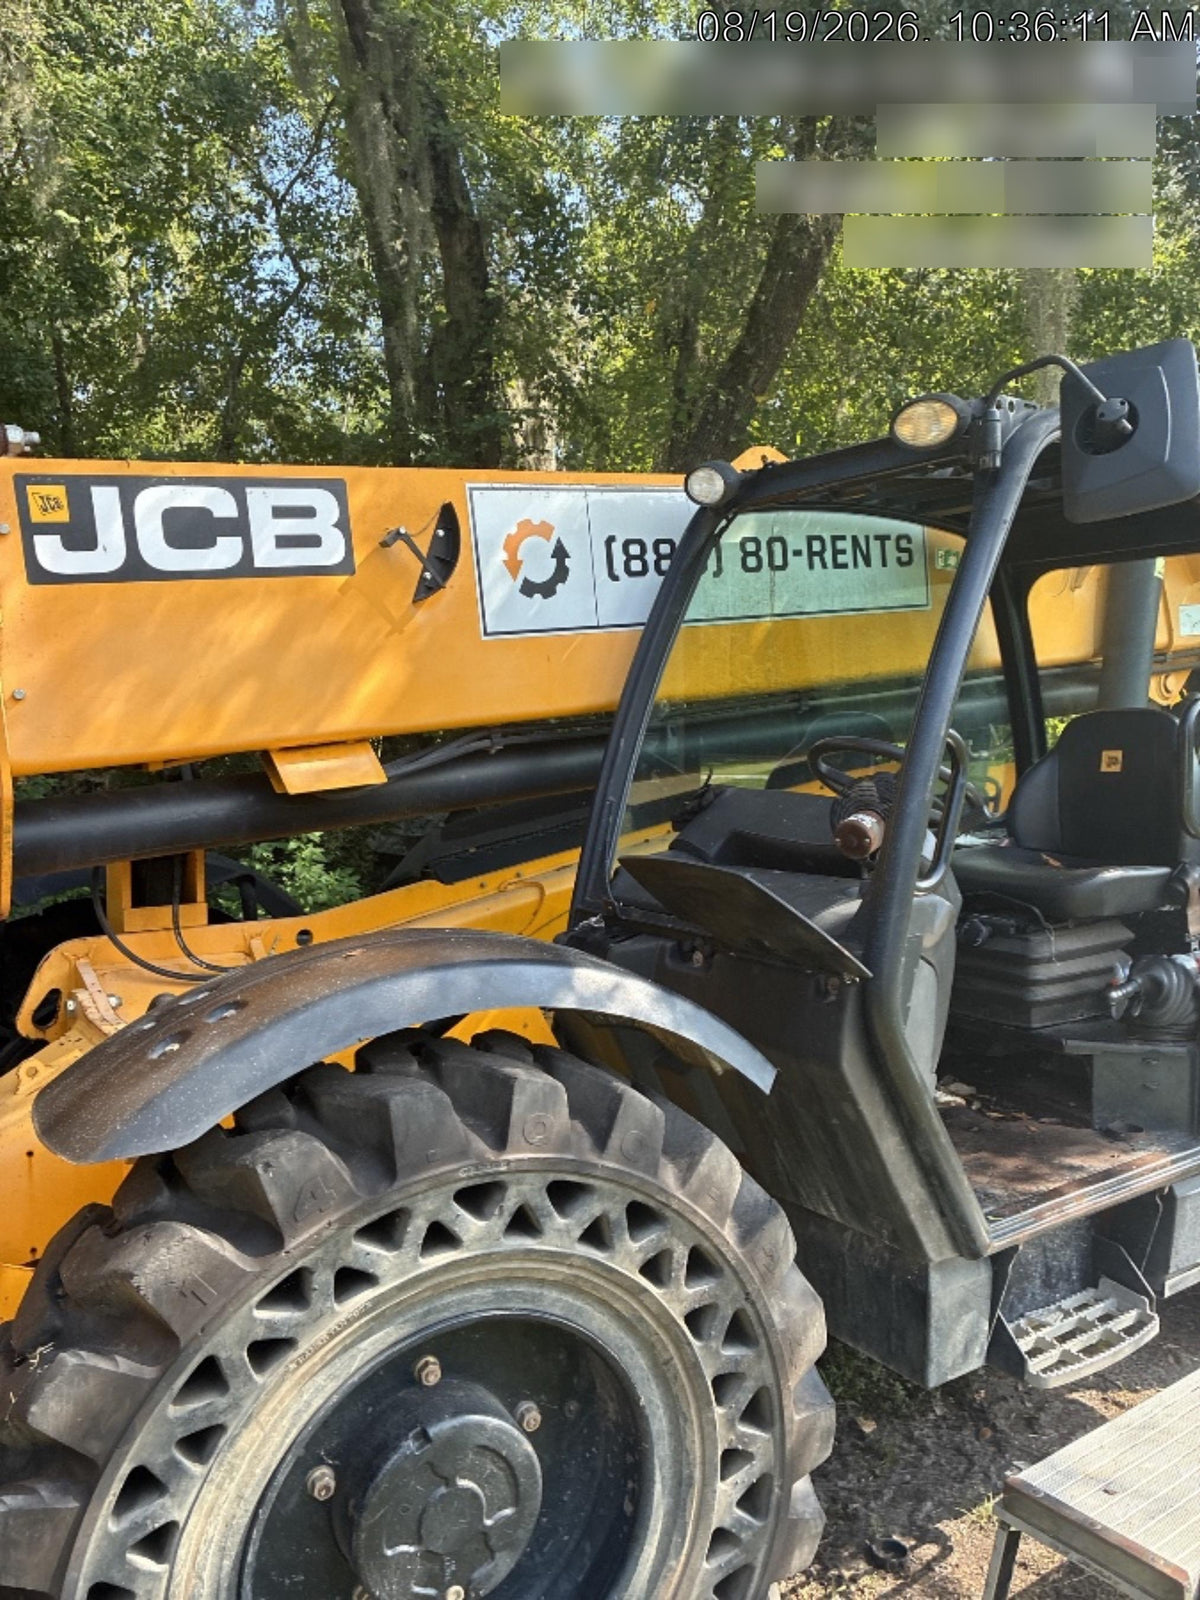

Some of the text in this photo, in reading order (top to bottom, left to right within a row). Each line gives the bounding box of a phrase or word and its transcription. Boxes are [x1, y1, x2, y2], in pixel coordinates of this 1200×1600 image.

[33, 485, 346, 575] JCB
[604, 534, 723, 581] (88)
[740, 533, 914, 573] 80-RENTS
